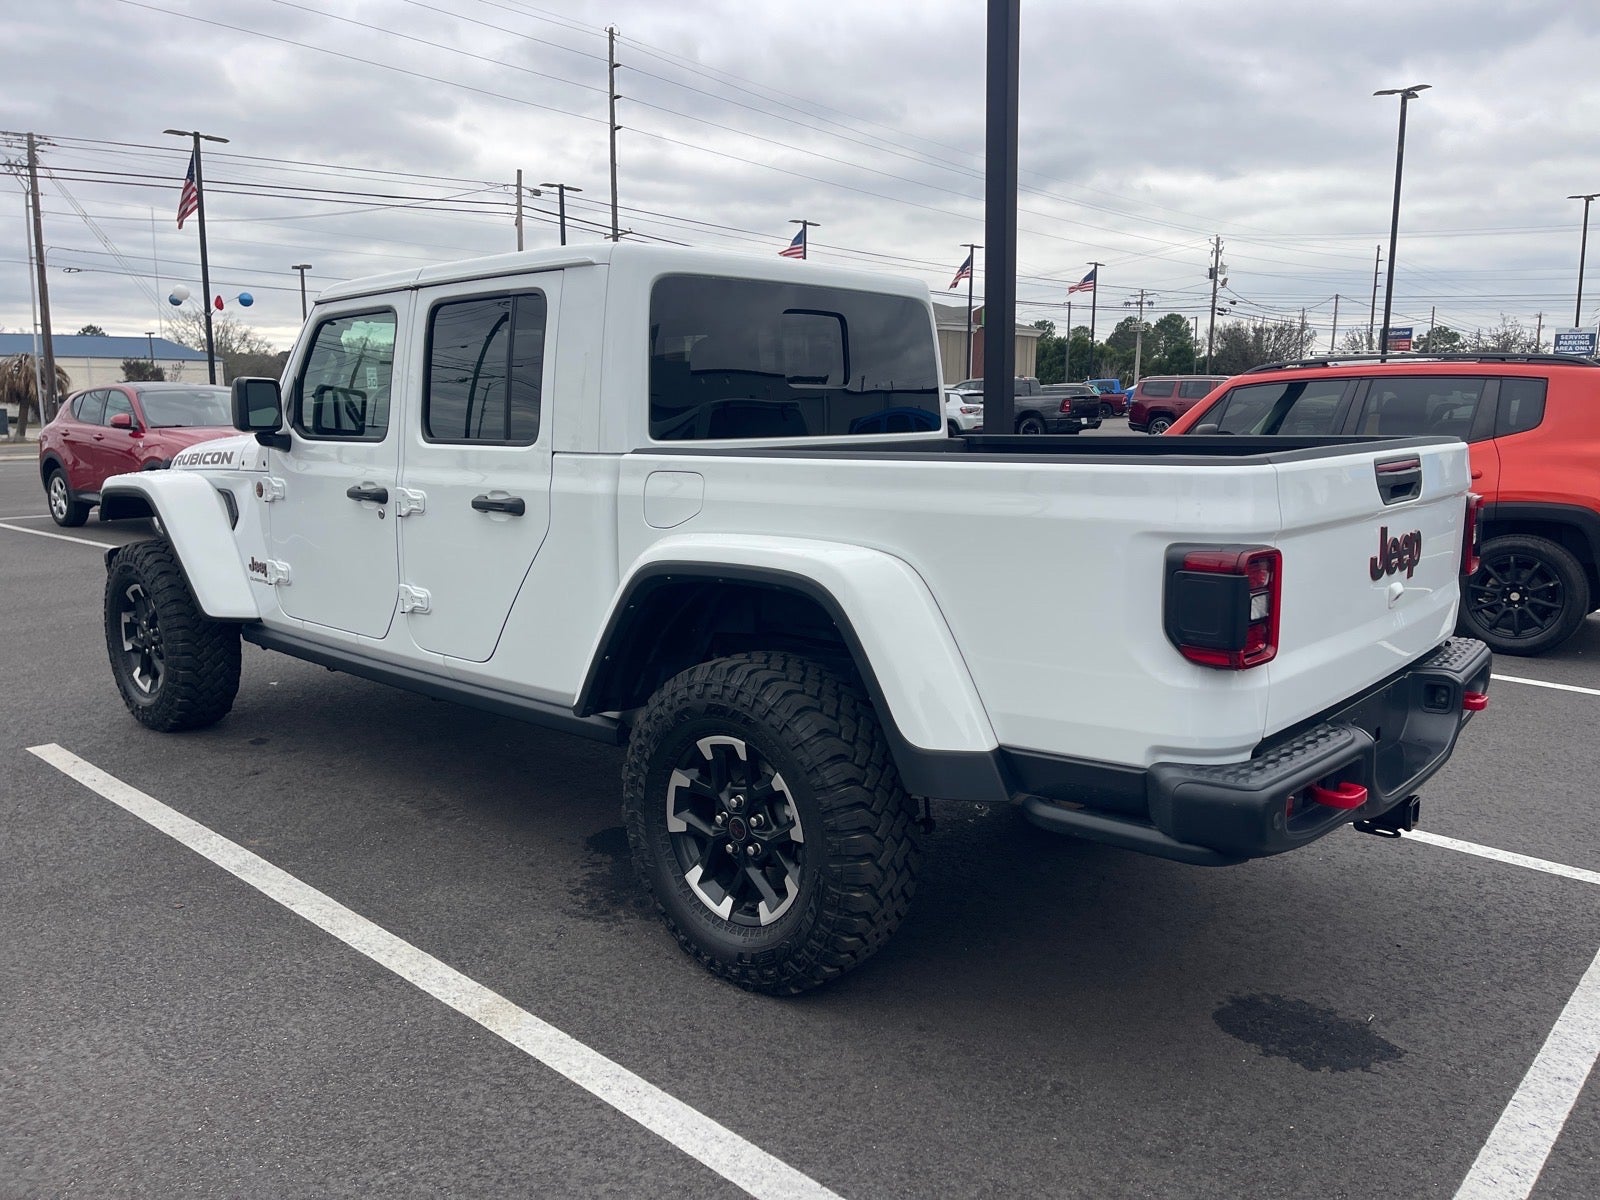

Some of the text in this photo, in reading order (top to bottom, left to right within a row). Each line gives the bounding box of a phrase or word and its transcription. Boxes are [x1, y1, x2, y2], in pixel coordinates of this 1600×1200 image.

[174, 451, 234, 466] RUBICON
[1370, 526, 1422, 581] Jeep
[249, 556, 268, 578] Jeep
